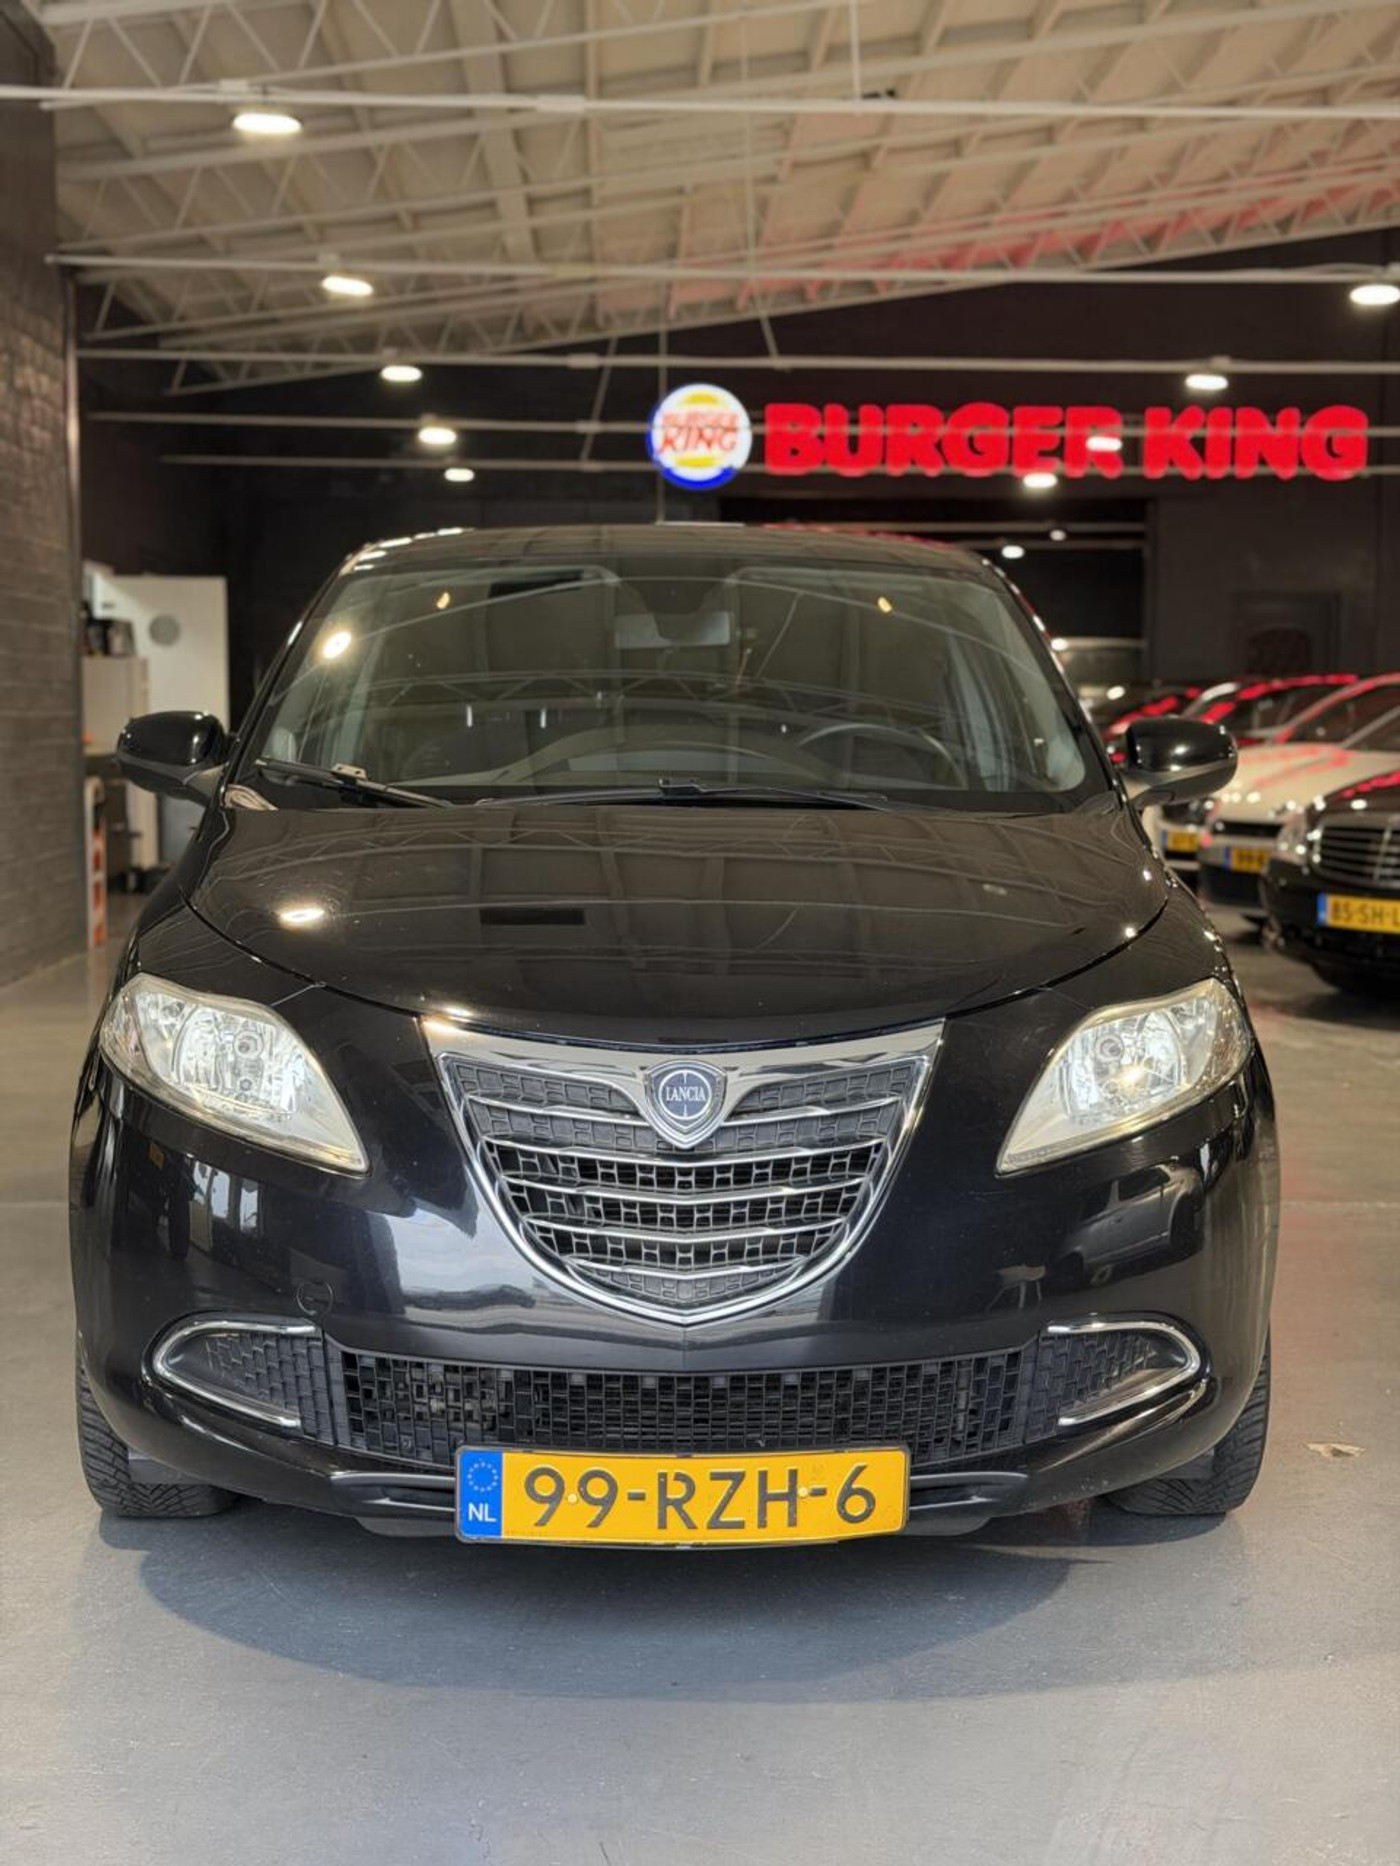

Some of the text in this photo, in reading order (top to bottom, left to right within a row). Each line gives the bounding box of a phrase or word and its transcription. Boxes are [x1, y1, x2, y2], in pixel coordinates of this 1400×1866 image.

[659, 425, 738, 453] KING
[765, 402, 1368, 481] BURGER KING
[665, 1086, 706, 1102] LANCIA
[524, 1464, 876, 1530] 99-RZH-6
[468, 1502, 497, 1522] NL
